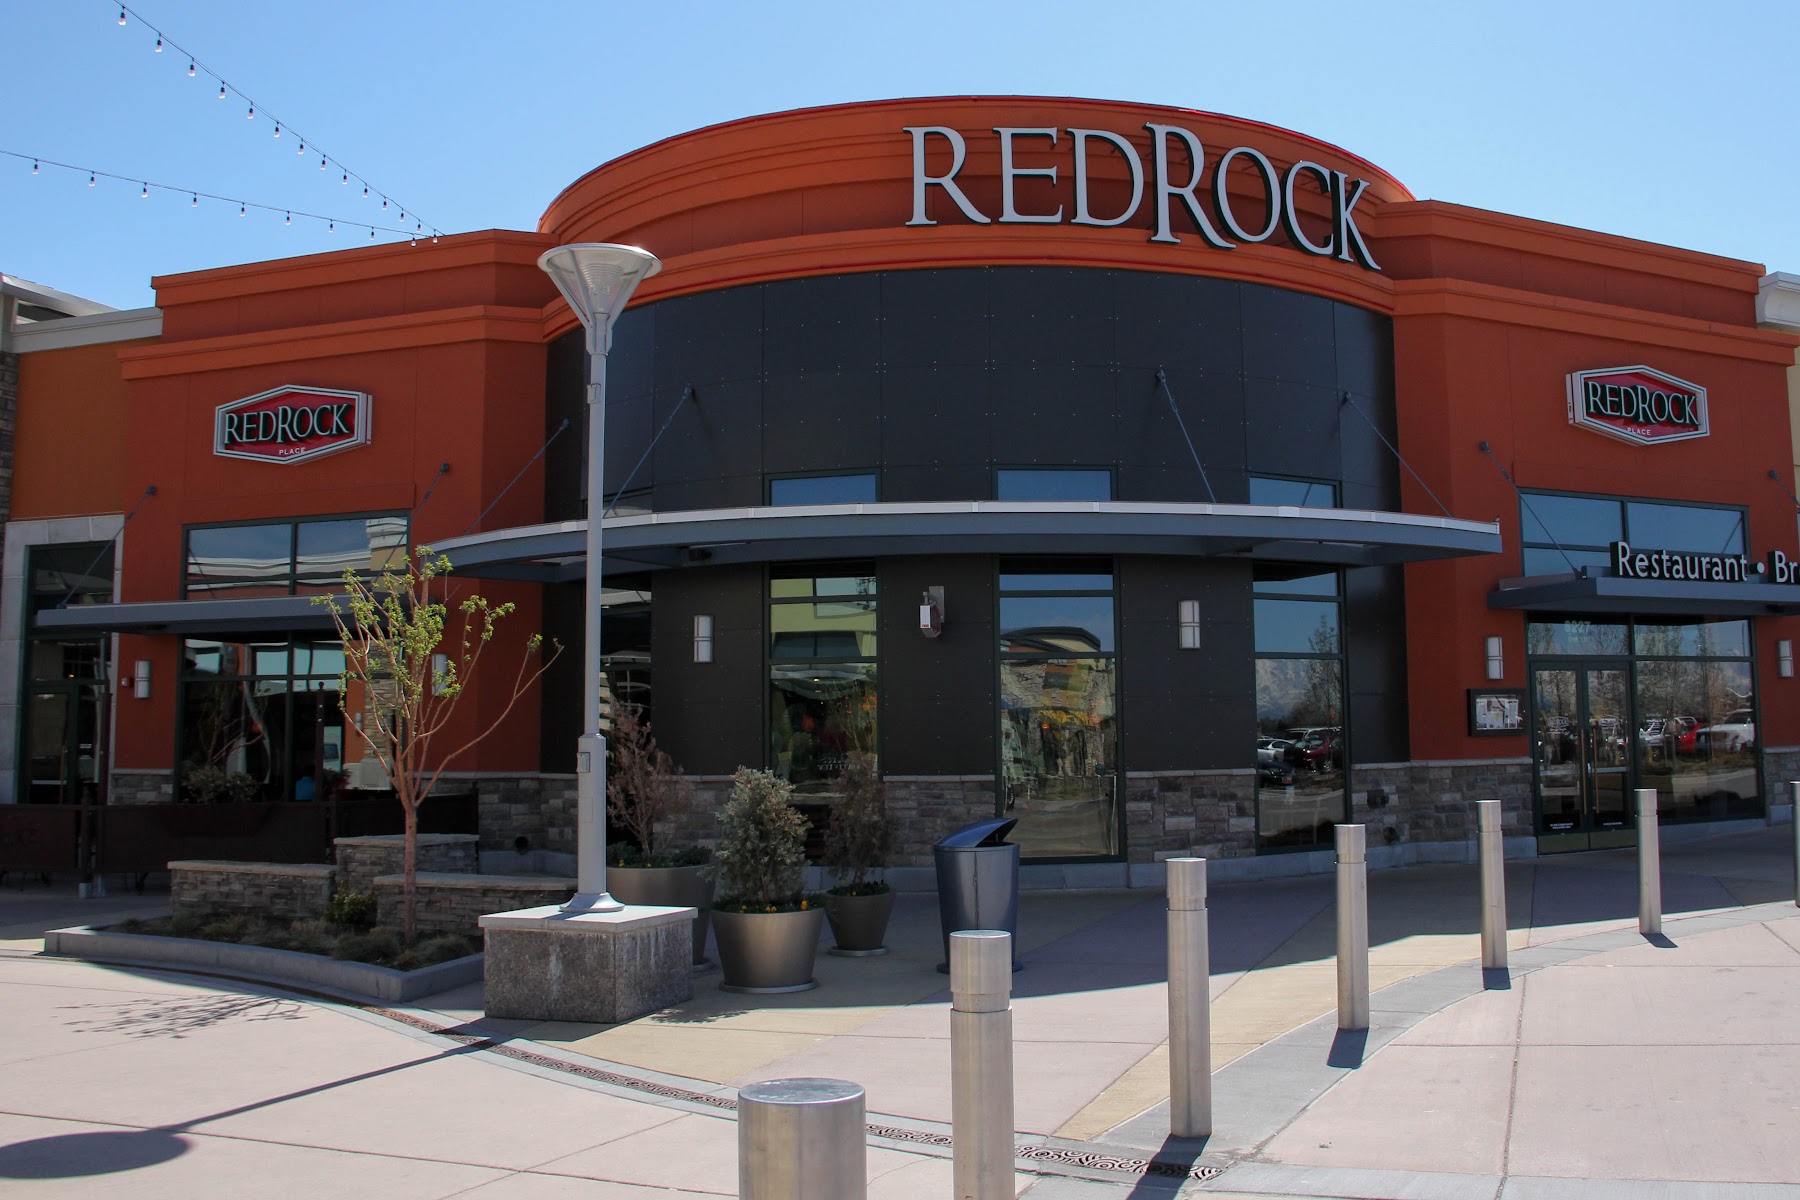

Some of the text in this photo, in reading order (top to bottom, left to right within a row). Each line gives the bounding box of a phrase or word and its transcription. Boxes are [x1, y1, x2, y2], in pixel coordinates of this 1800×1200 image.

[902, 121, 1382, 271] REDROCK
[1586, 380, 1701, 426] REDROCK
[223, 403, 350, 445] REDROCK
[1627, 427, 1652, 436] PLACE
[278, 446, 306, 456] PLACE
[1617, 541, 1748, 582] Restaurant
